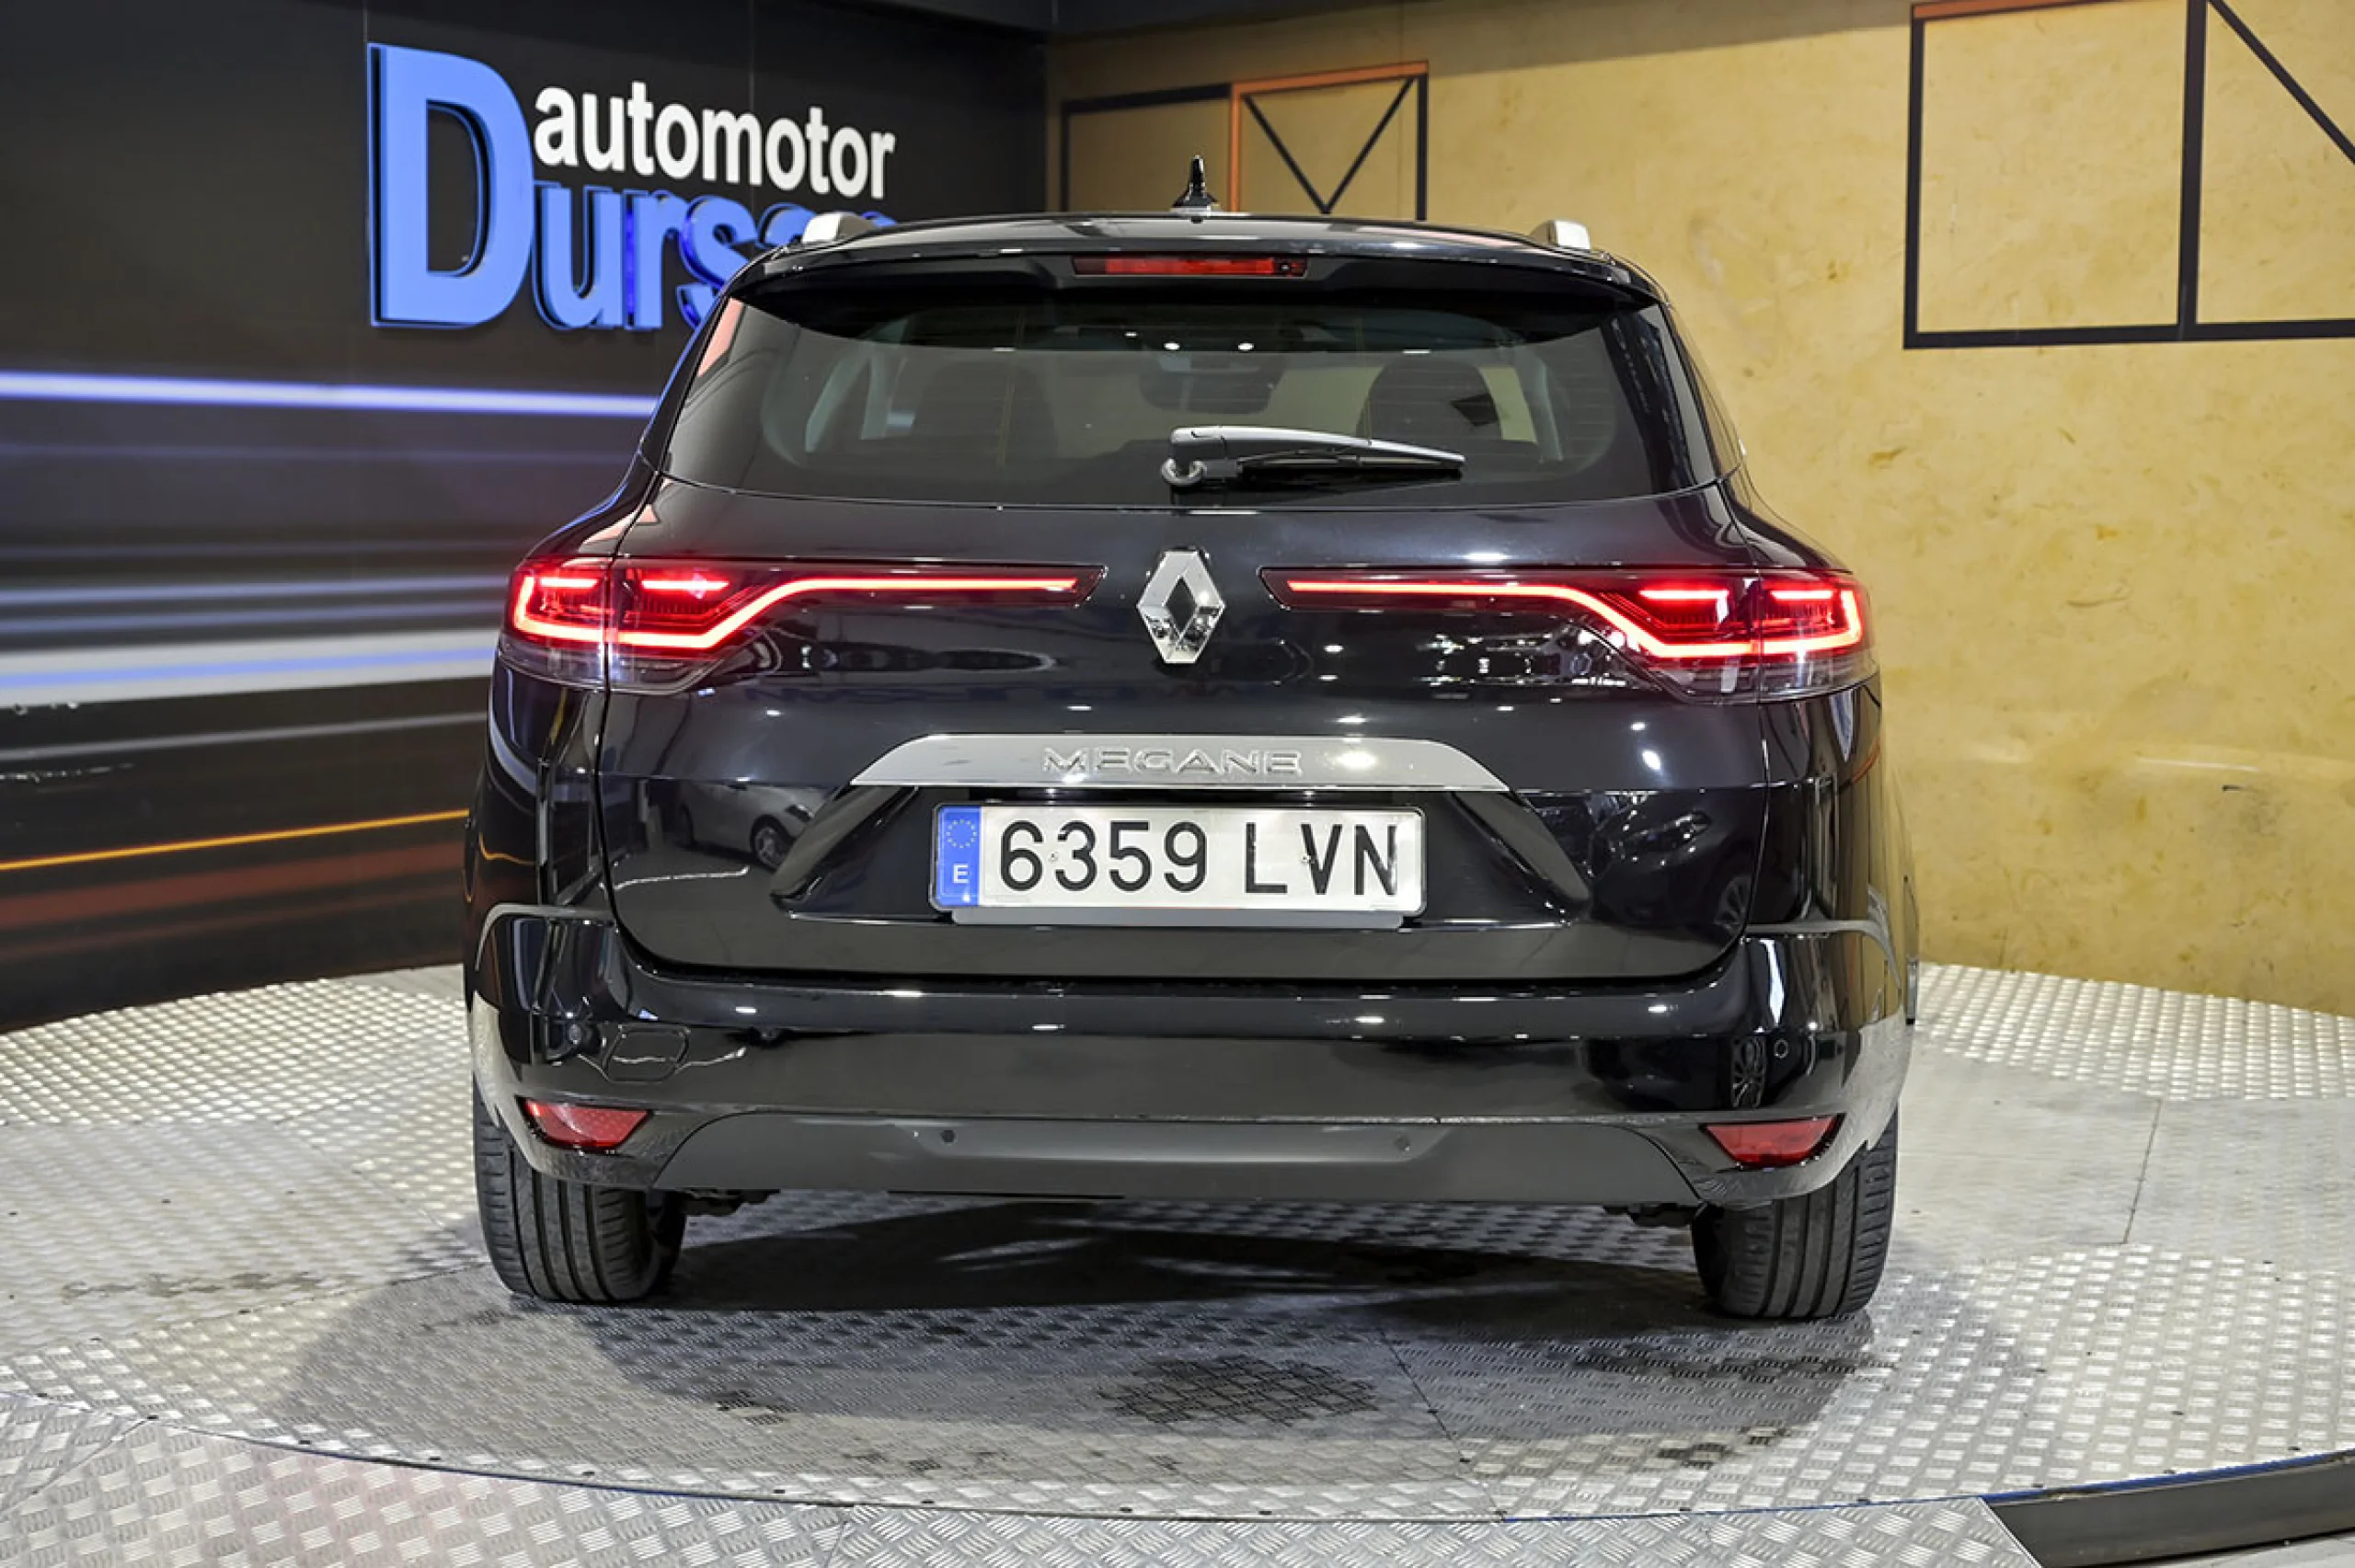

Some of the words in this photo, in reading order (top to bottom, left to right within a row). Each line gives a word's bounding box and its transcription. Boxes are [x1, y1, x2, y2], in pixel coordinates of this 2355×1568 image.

[534, 81, 896, 199] automotor
[367, 42, 898, 330] Durs
[1042, 747, 1303, 775] MEGANE
[952, 863, 970, 884] E
[999, 820, 1208, 893] 6359
[1244, 821, 1398, 896] LVN
